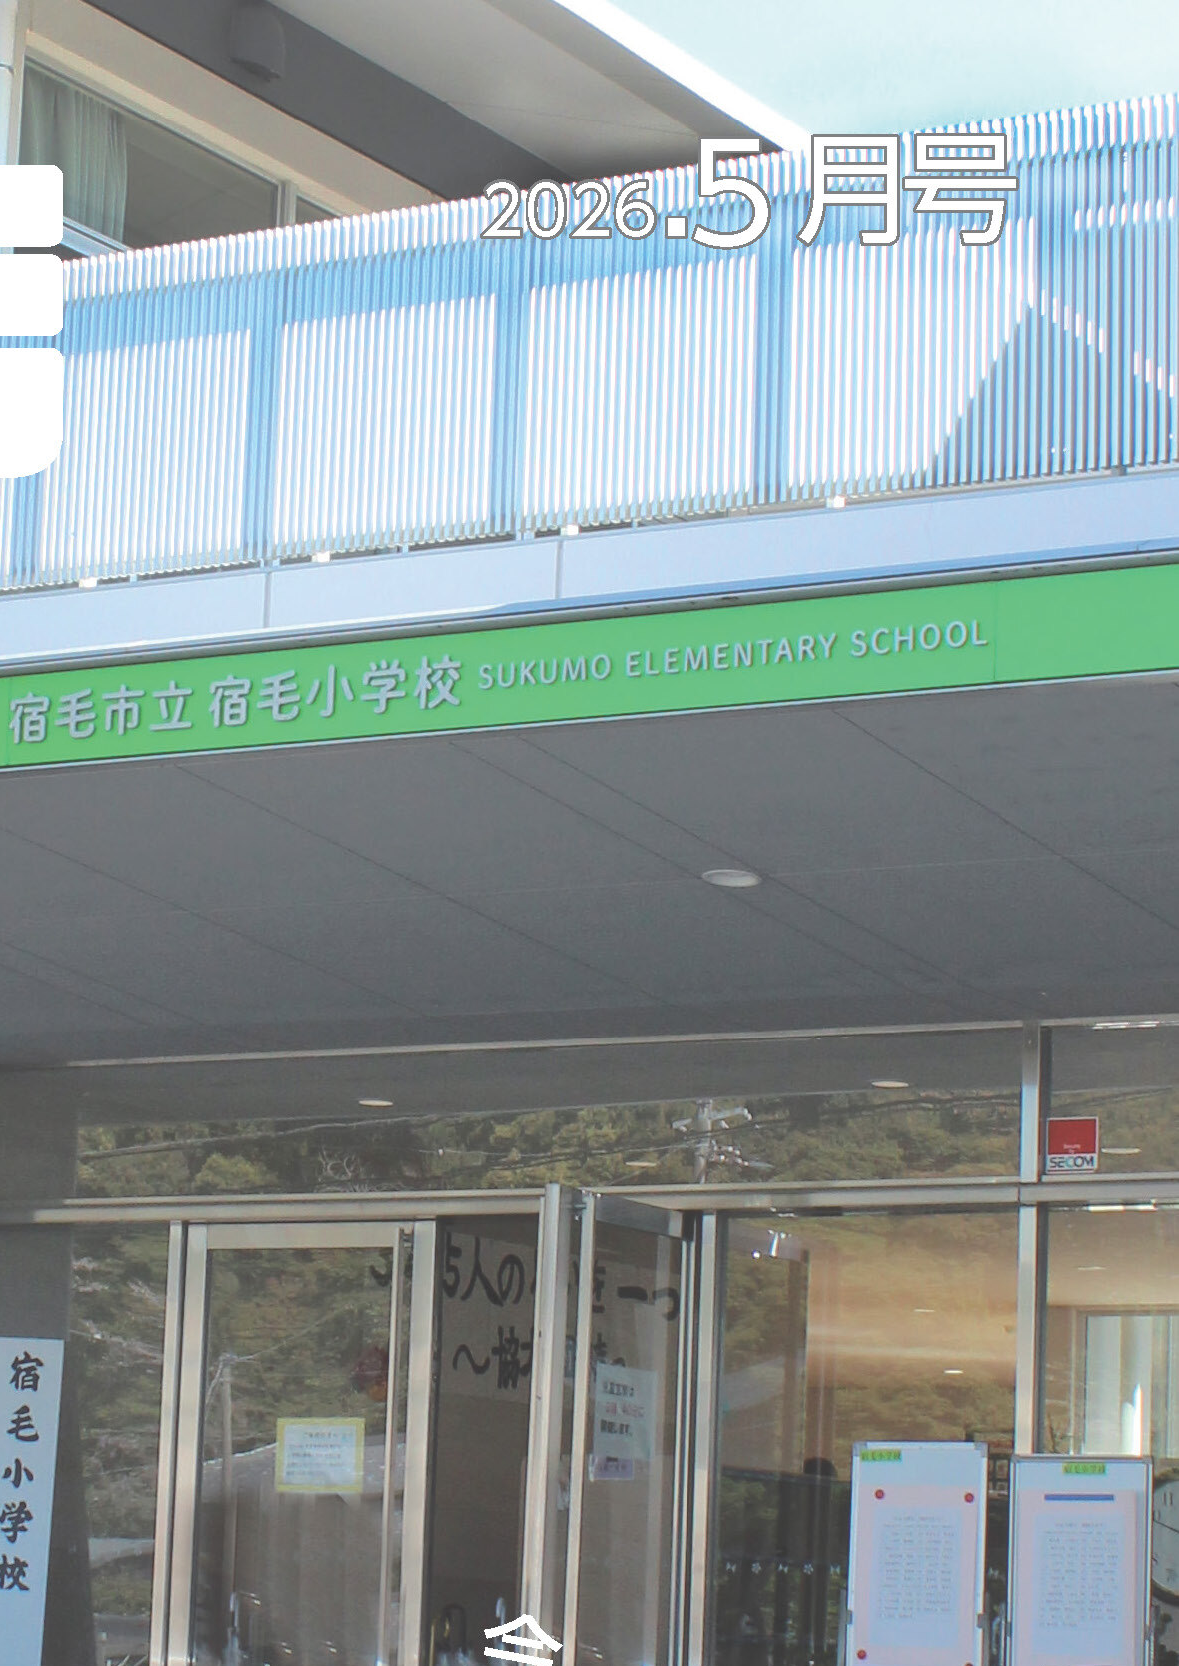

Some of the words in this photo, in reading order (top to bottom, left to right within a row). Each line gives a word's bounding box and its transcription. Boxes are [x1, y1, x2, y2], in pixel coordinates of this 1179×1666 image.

[478, 654, 612, 690] SUKUMO
[626, 632, 837, 678] ELEMENTARY
[850, 619, 988, 657] SCHOOL
[1049, 1155, 1095, 1169] SECOM
